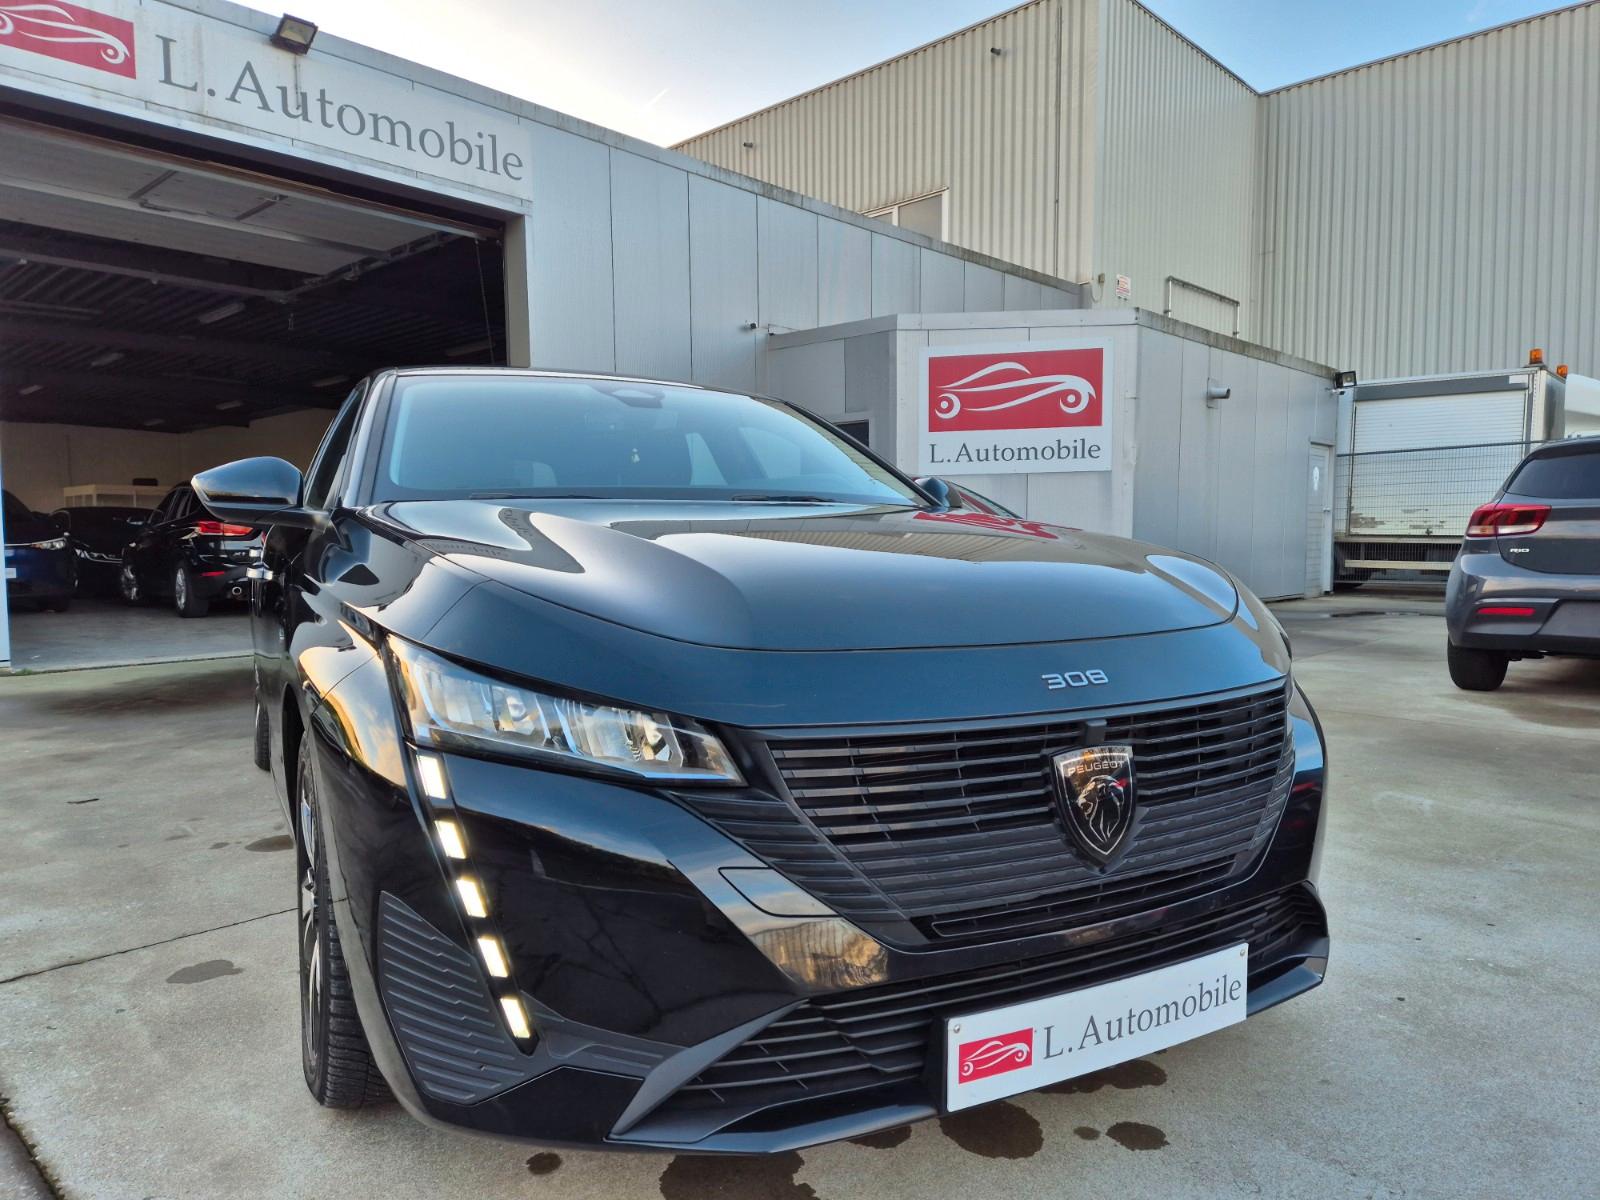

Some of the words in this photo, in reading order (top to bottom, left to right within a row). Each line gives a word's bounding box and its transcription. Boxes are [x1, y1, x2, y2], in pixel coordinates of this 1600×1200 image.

[156, 35, 523, 180] L.Automobile
[929, 438, 1101, 463] L.Automobile
[1042, 669, 1109, 689] 308
[1067, 760, 1125, 775] PEUGEOT
[1043, 974, 1242, 1059] L.Automobile
